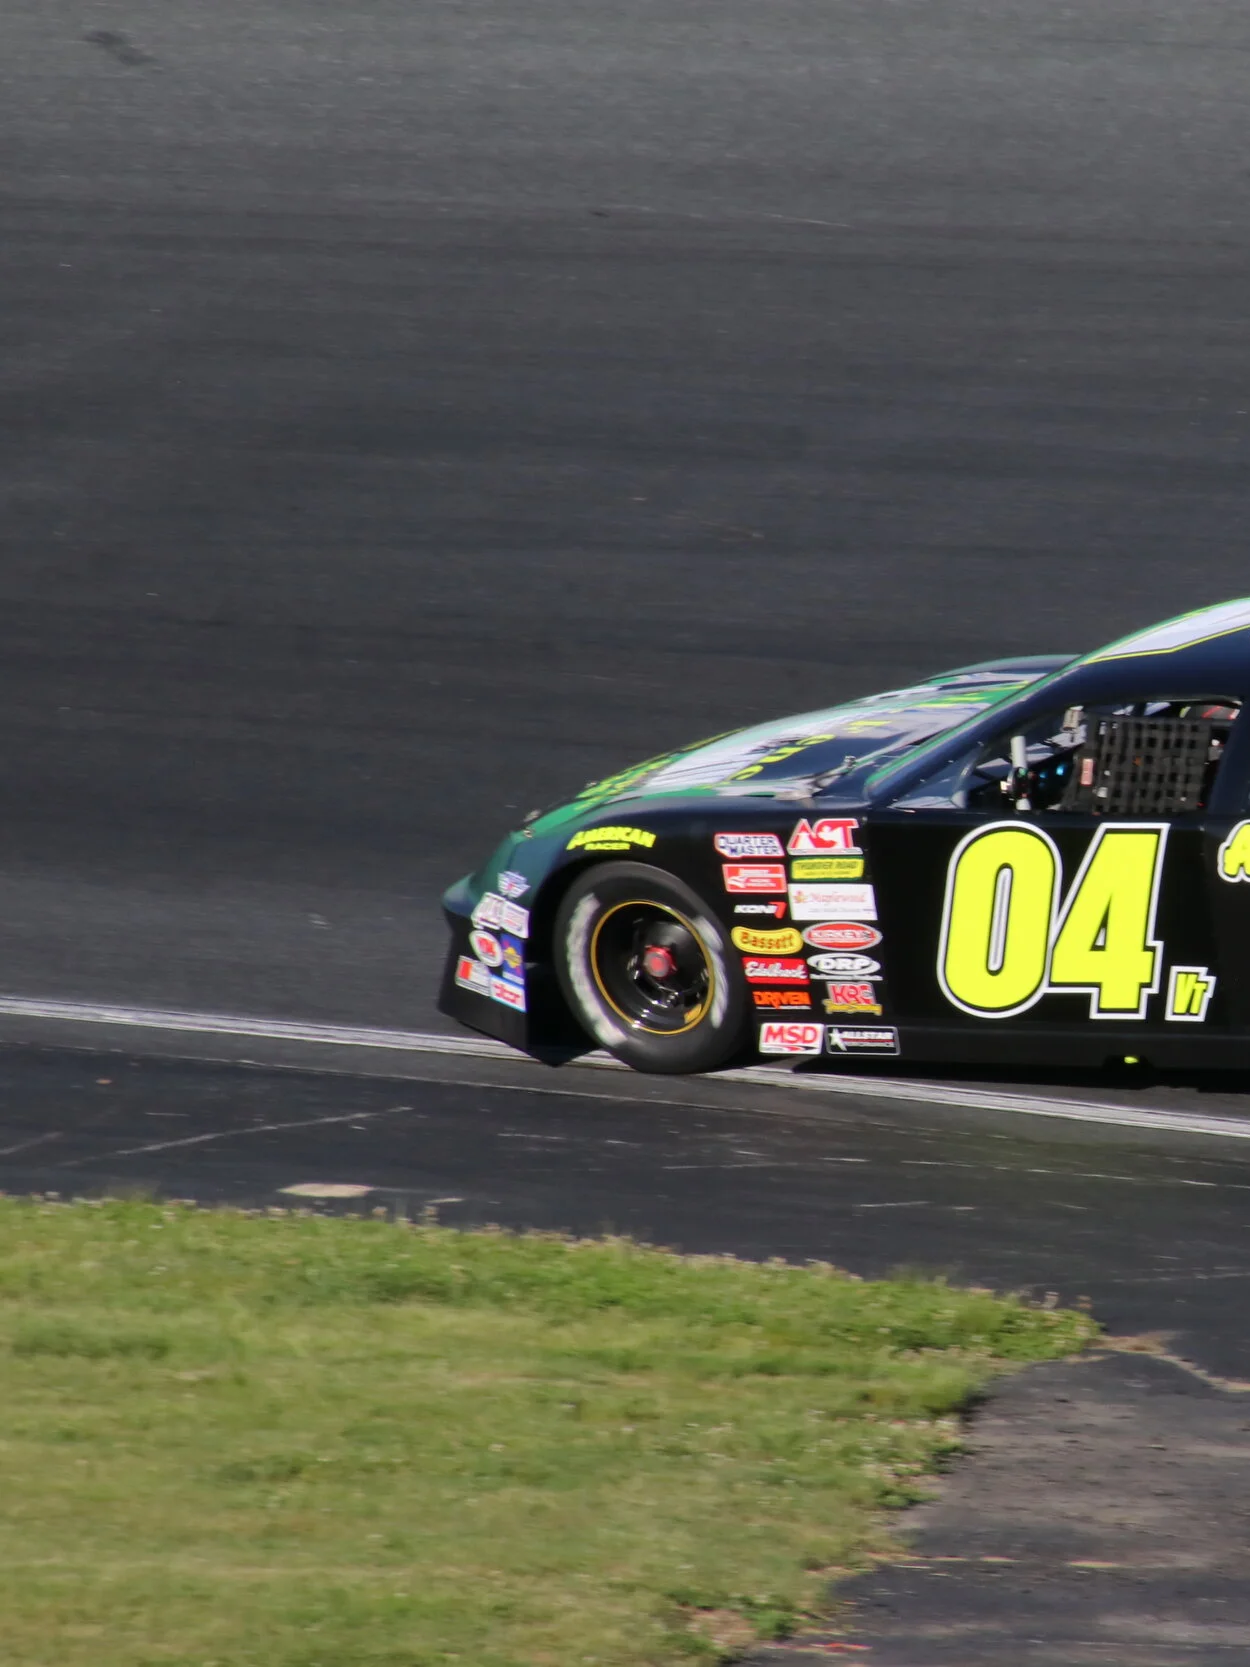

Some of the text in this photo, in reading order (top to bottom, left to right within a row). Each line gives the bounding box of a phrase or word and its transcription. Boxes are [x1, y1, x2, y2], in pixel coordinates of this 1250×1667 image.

[566, 826, 656, 850] AMERICAN
[719, 836, 775, 847] QUARTER
[730, 845, 779, 855] MASTER
[937, 820, 1171, 1020] 04
[741, 932, 794, 949] Bassett
[819, 958, 871, 969] DRP
[753, 991, 811, 1007] DRIVEN
[764, 1026, 817, 1043] MSD
